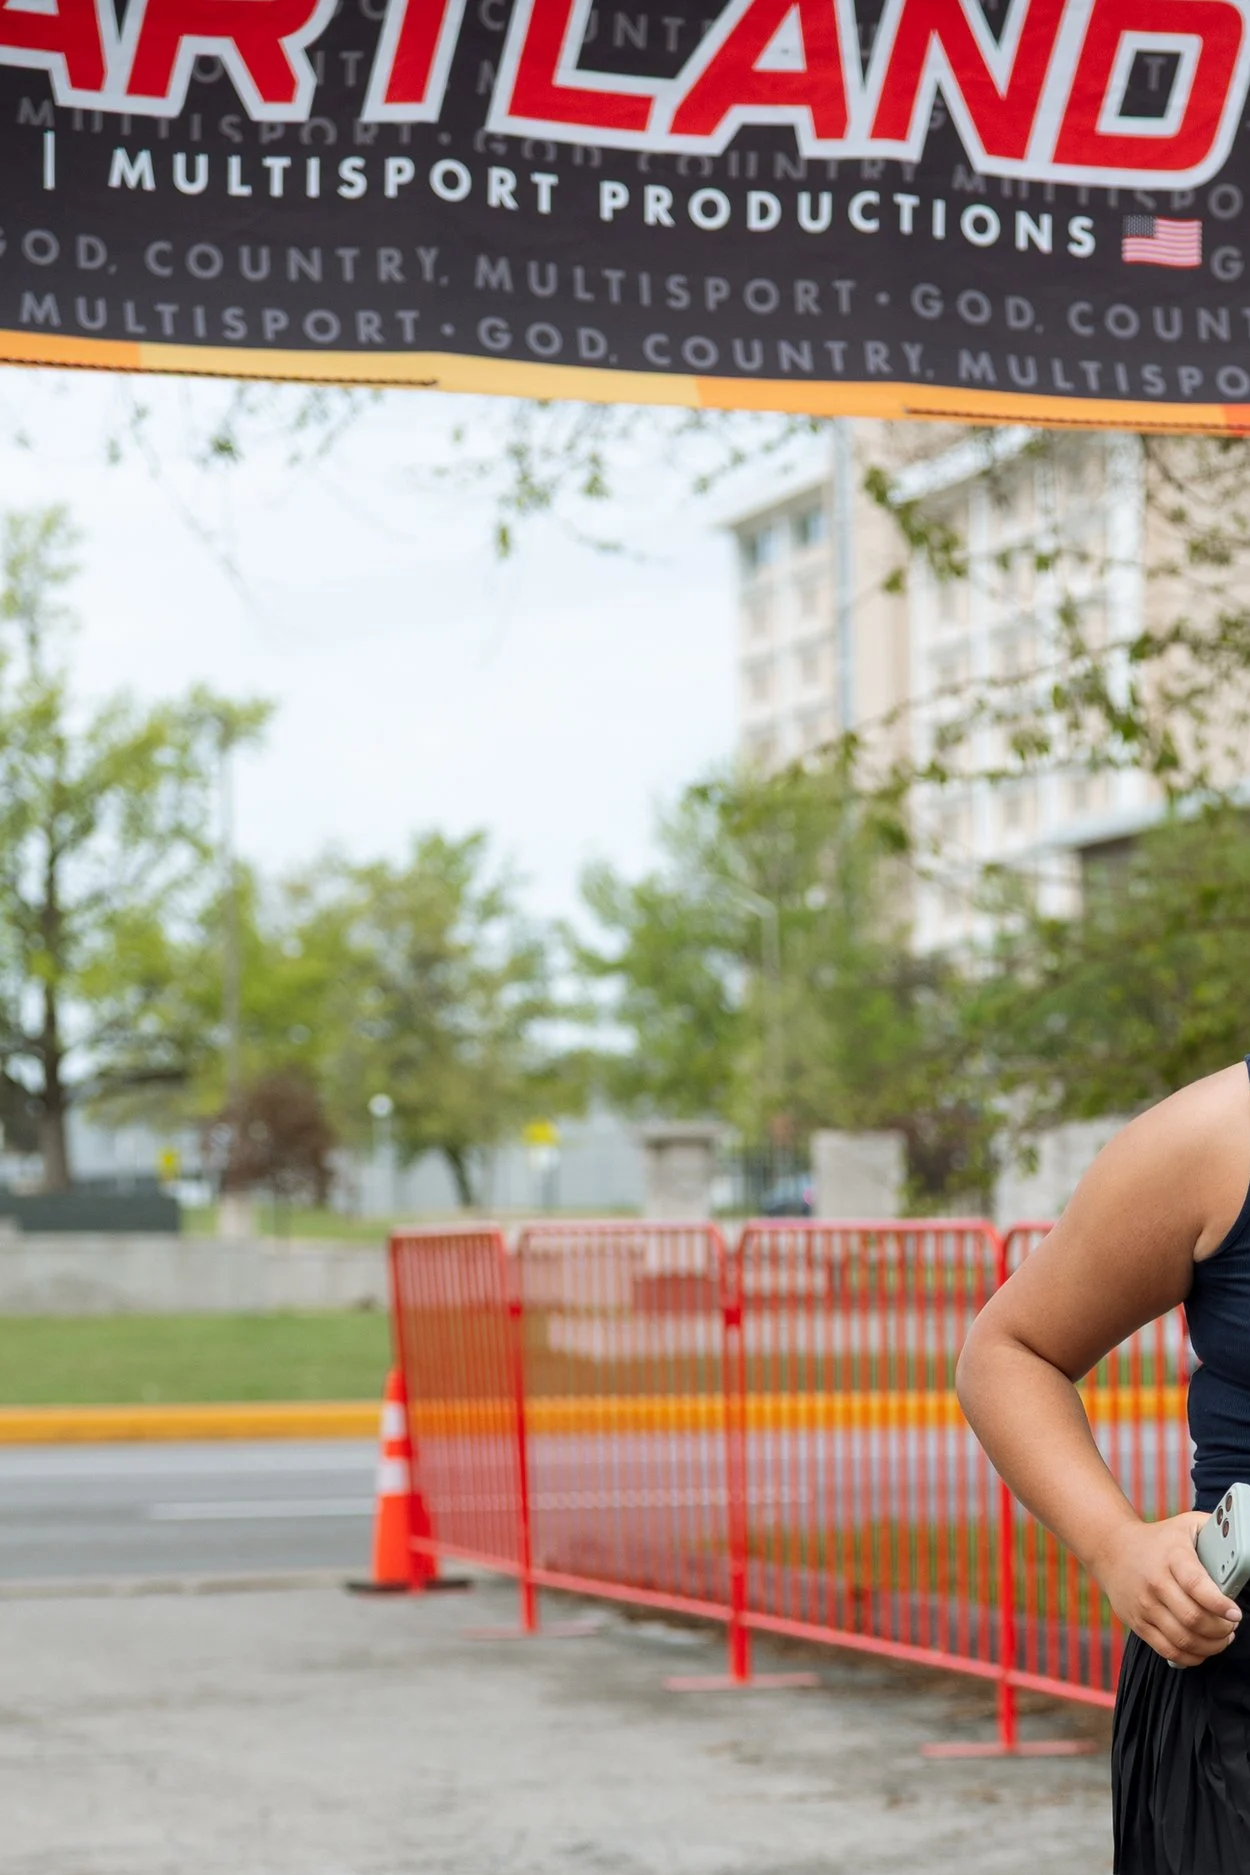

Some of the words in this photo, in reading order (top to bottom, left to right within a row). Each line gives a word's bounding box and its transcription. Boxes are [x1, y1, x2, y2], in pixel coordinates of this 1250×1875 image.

[107, 147, 559, 215] MULTISPORT
[599, 180, 1097, 258] PRODUCTIONS
[474, 254, 857, 315] MULTISPORT
[19, 291, 420, 344] MULTISPORT
